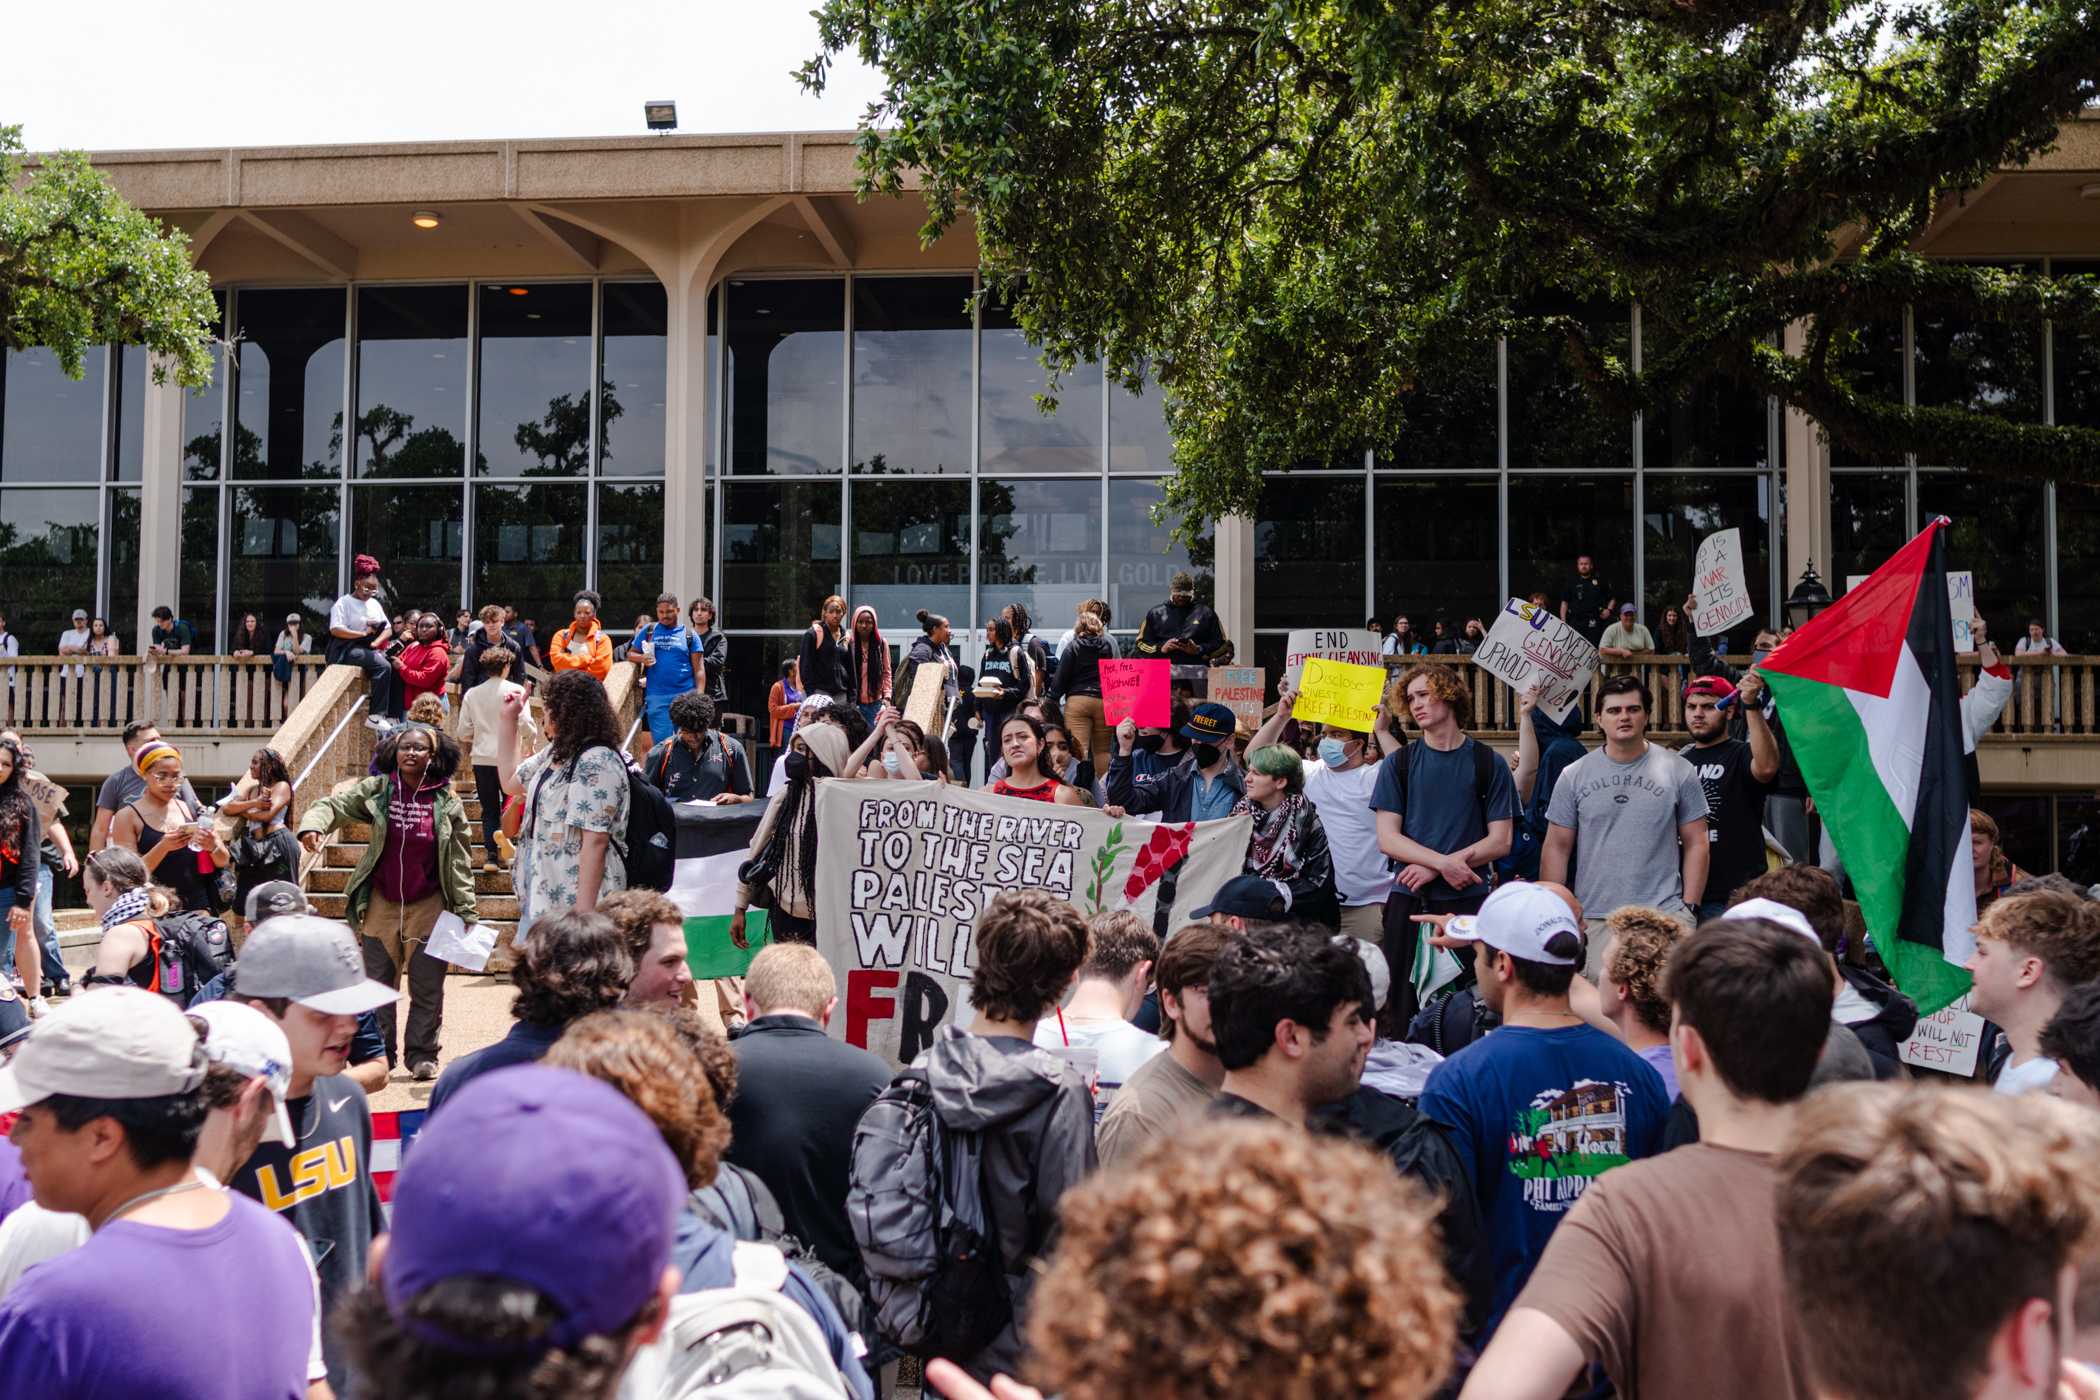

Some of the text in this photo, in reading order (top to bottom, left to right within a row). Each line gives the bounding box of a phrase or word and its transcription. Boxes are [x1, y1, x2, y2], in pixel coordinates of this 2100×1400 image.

[1060, 563, 1101, 584] LIV
[1700, 566, 1729, 589] WAR
[1704, 582, 1734, 606] ITS
[1315, 632, 1348, 649] END
[1478, 636, 1532, 681] UPHOLD
[1523, 631, 1583, 676] GENOCIDE
[31, 782, 57, 804] OSE
[1583, 774, 1665, 798] COLORADO
[859, 799, 1084, 849] FROM THE RIVER
[858, 830, 1074, 891] TO THE SEA
[851, 869, 1071, 921] PALEST
[849, 912, 975, 980] WILL
[1926, 1010, 1956, 1024] TOP
[1918, 1024, 1976, 1049] WILL NOT
[1909, 1041, 1961, 1064] REST
[255, 1136, 357, 1213] LSU
[1523, 1177, 1551, 1201] PHI
